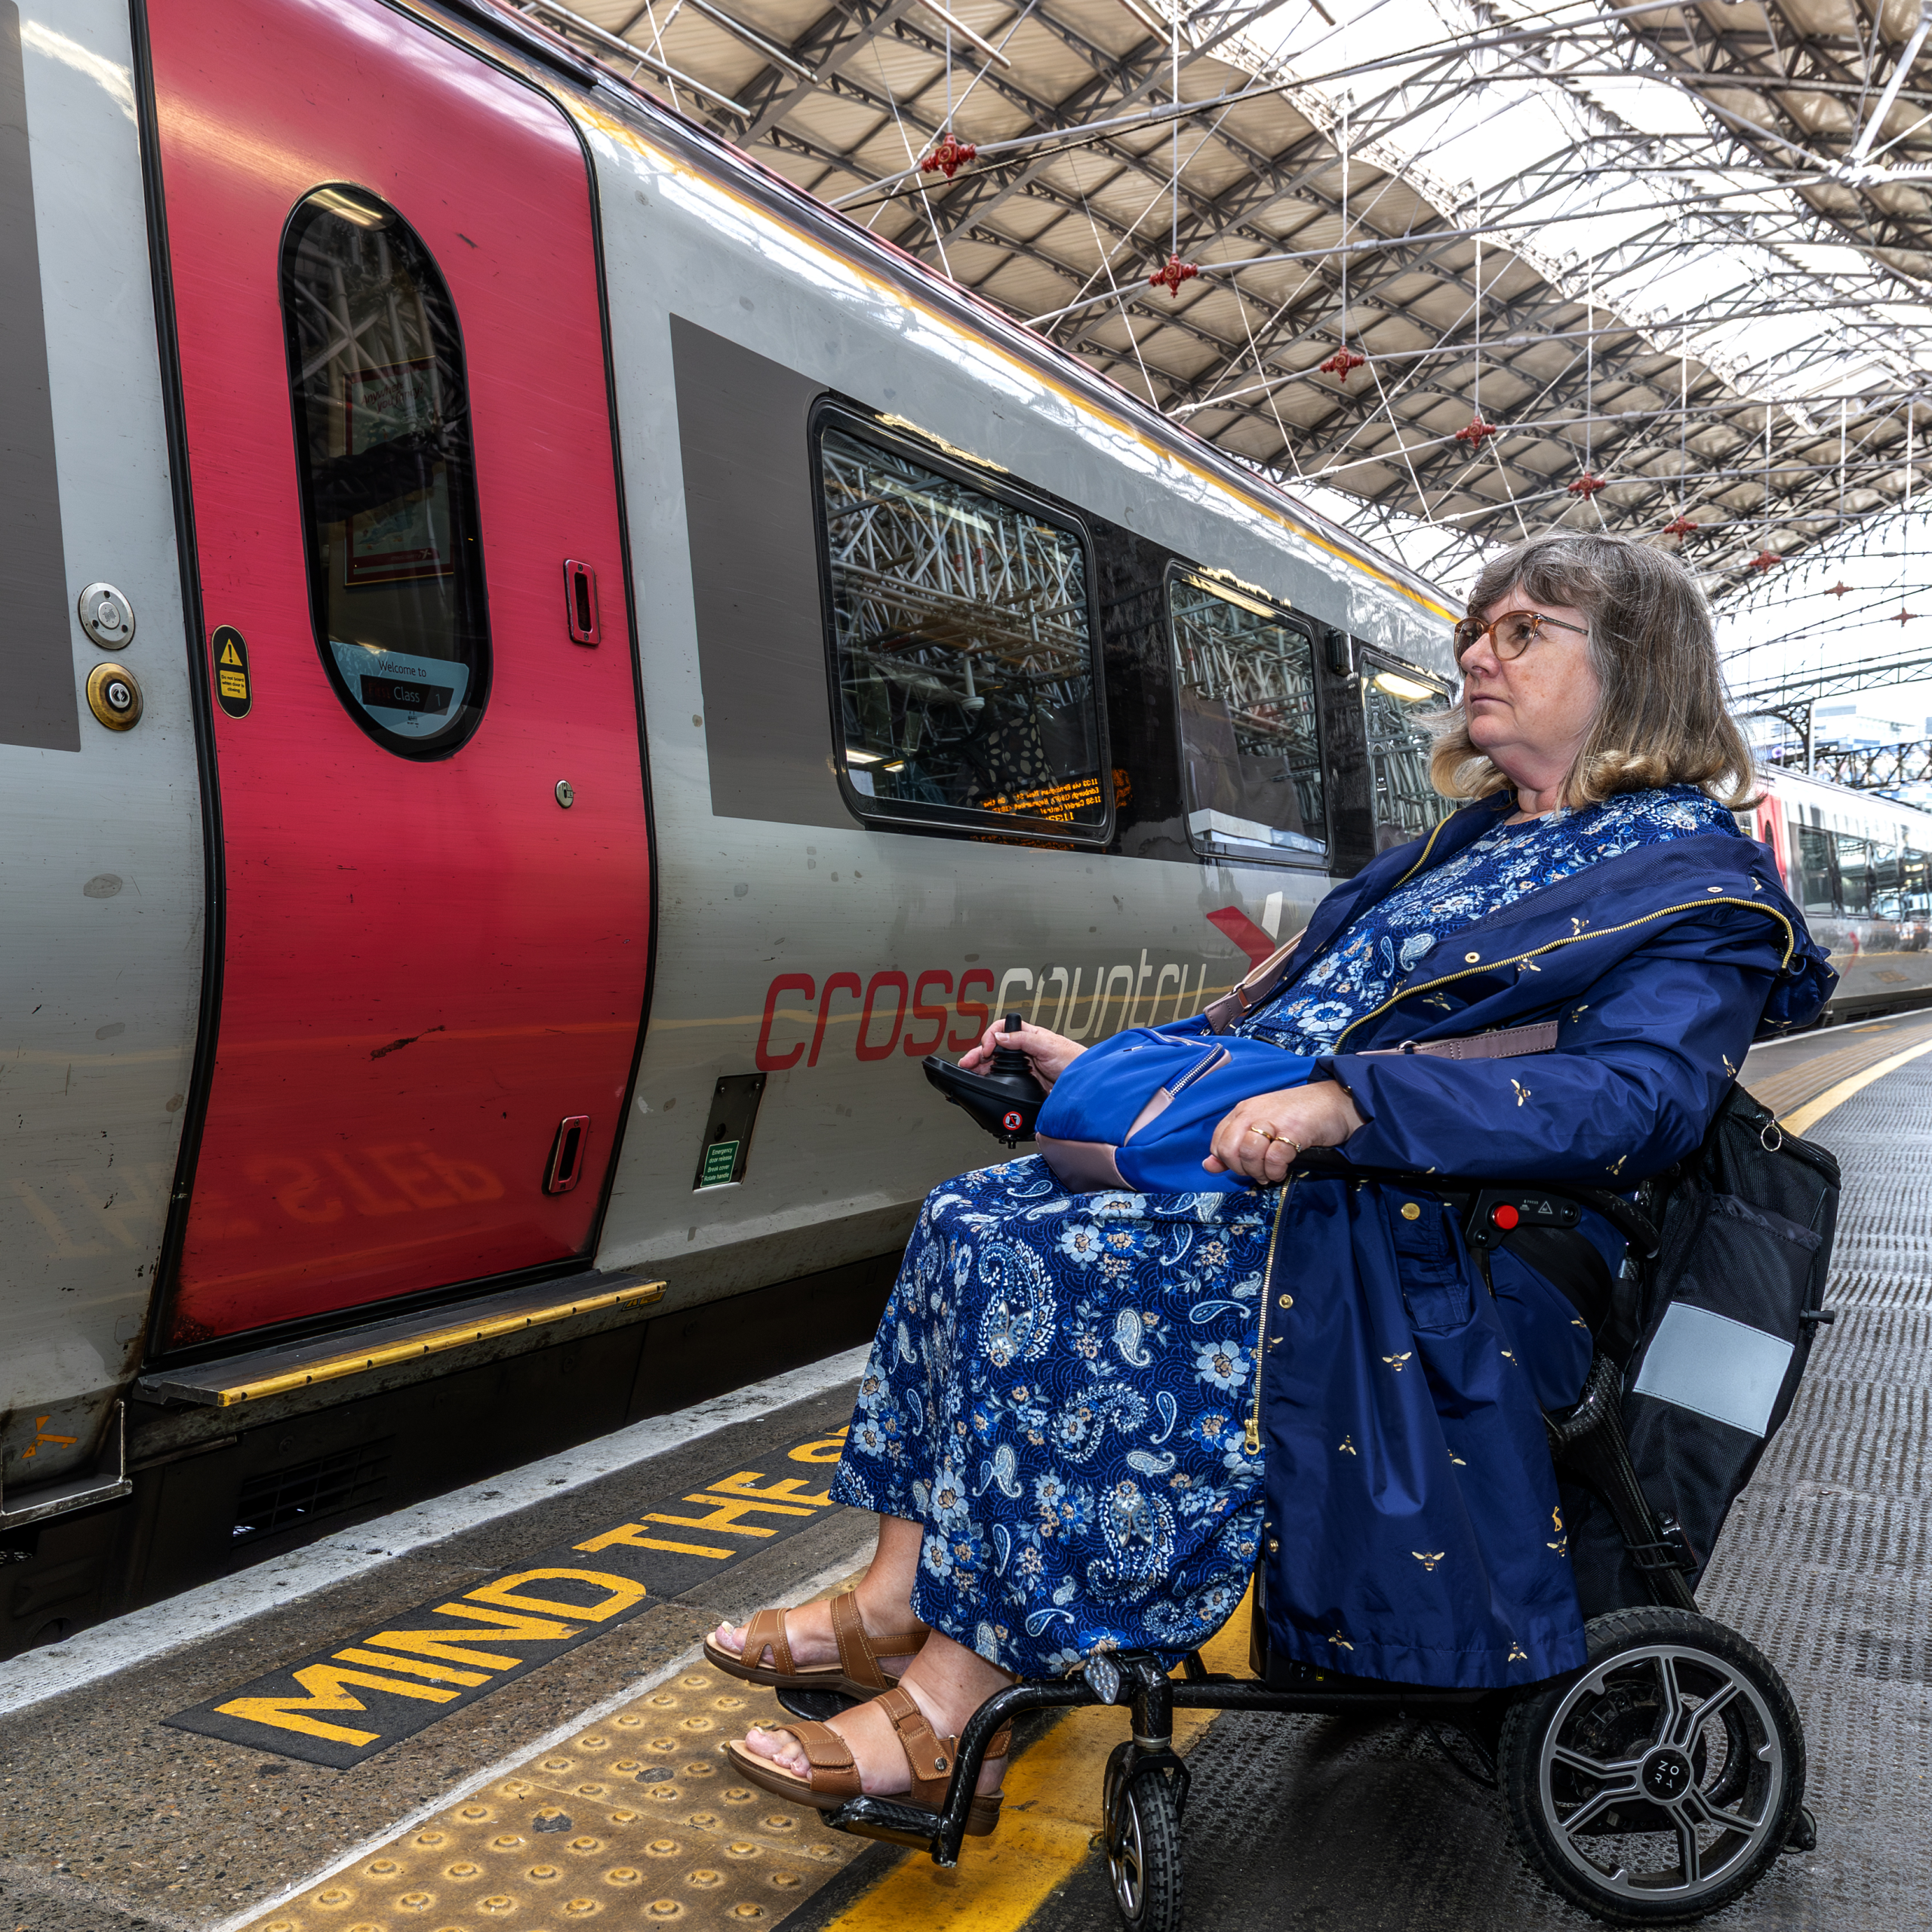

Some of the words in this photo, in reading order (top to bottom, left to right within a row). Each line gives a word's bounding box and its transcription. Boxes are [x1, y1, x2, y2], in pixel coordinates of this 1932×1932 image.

[377, 398, 393, 414] you
[378, 660, 416, 677] Welcome
[417, 666, 427, 678] to
[393, 685, 420, 703] Class
[435, 693, 442, 707] 1
[213, 1567, 647, 1748] MIND
[571, 1470, 835, 1561] THE
